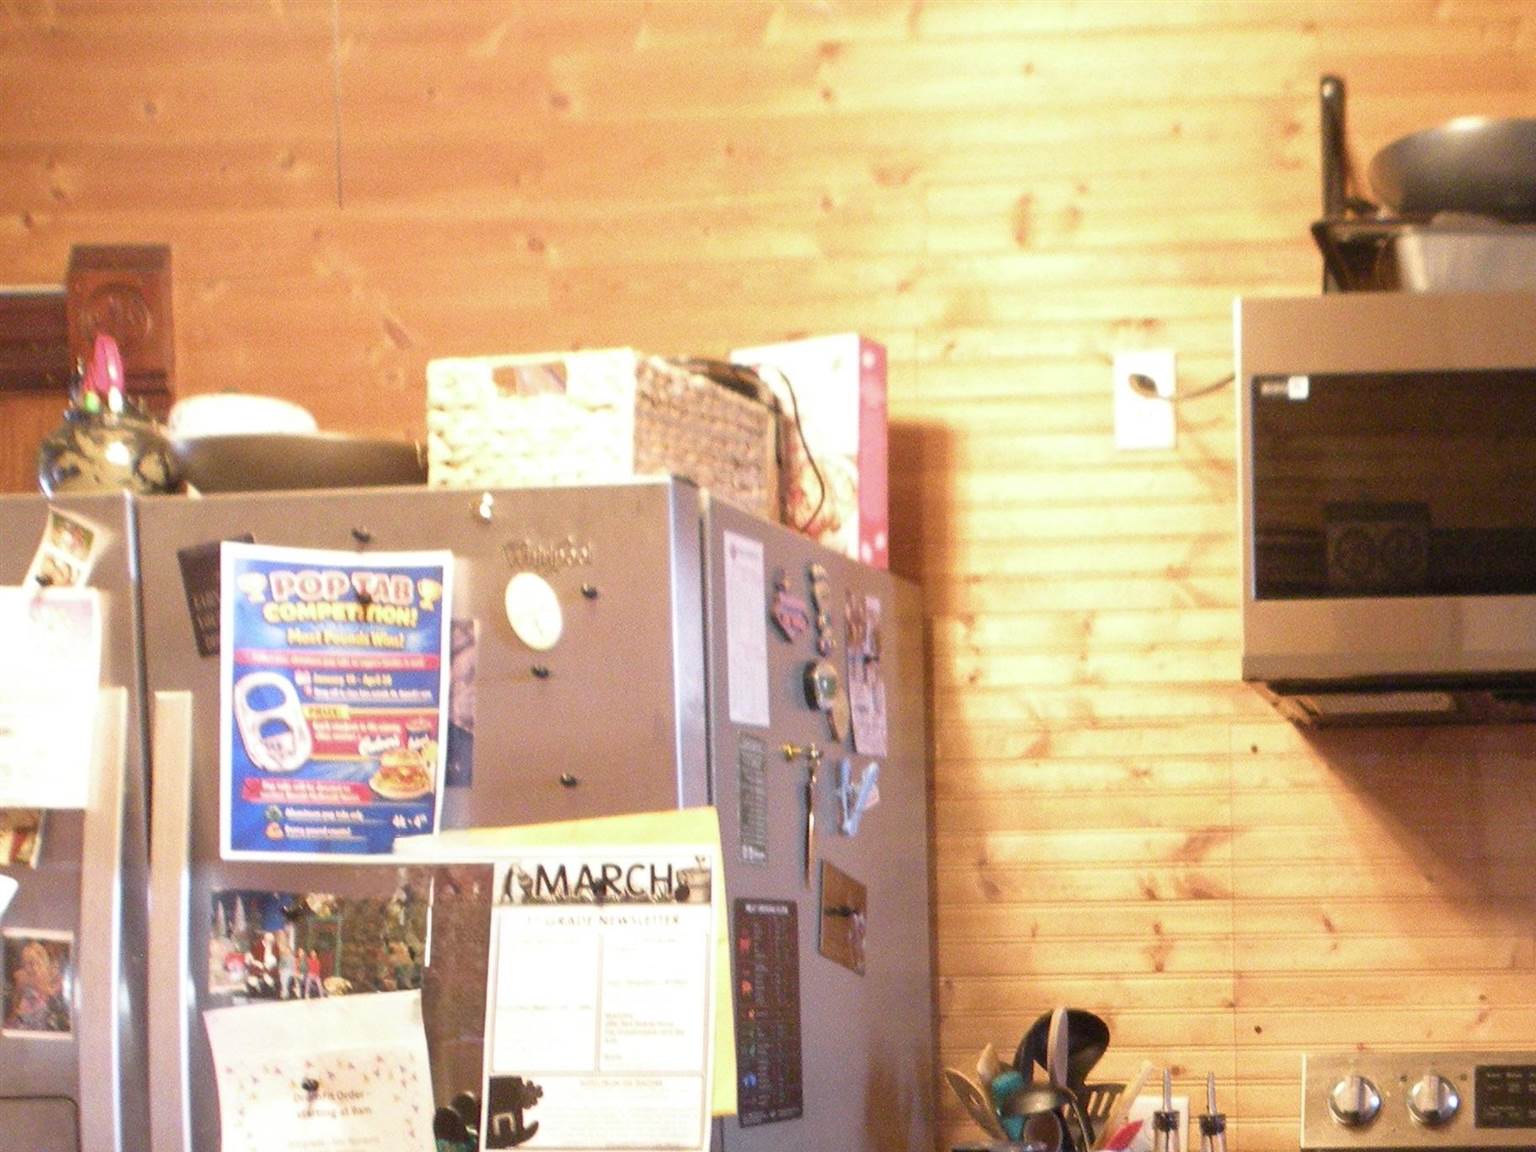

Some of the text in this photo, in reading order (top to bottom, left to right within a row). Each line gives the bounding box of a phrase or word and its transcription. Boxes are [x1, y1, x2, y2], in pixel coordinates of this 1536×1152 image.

[269, 571, 414, 606] POP TAB
[263, 601, 418, 628] COMPETITION!
[535, 863, 673, 898] MARCH
[599, 914, 679, 927] NEWSLETTER
